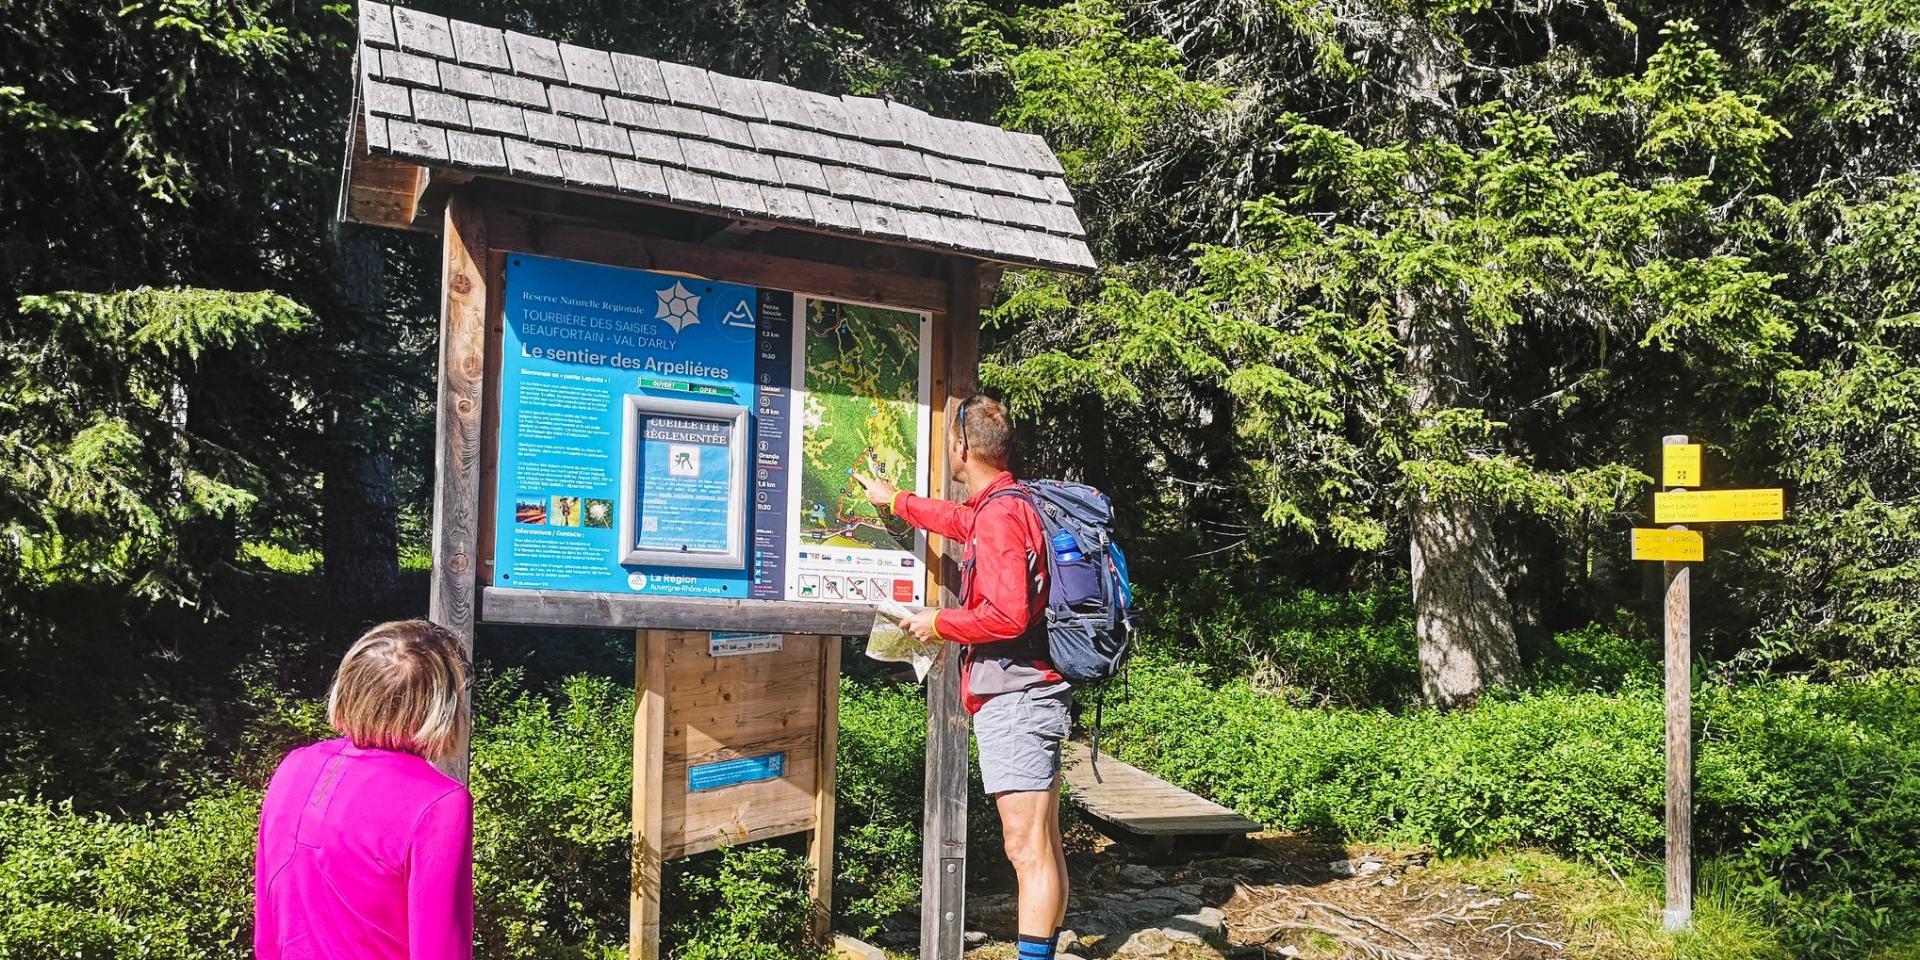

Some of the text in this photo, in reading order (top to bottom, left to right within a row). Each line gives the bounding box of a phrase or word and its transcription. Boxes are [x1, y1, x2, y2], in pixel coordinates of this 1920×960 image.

[560, 296, 601, 309] Naturelle
[590, 316, 612, 330] DES
[615, 319, 657, 335] SAISIES
[522, 323, 604, 342] BEAUFORTAIN
[613, 335, 635, 347] VAL
[638, 337, 677, 350] D'ARLY
[521, 342, 542, 358] Le
[546, 346, 607, 365] sentier
[610, 352, 640, 369] des
[652, 381, 675, 389] OUVERT
[650, 417, 720, 431] CUEILLETTE
[650, 573, 697, 585] La Région
[650, 583, 720, 594] Auvergne-Rhône-Alpes
